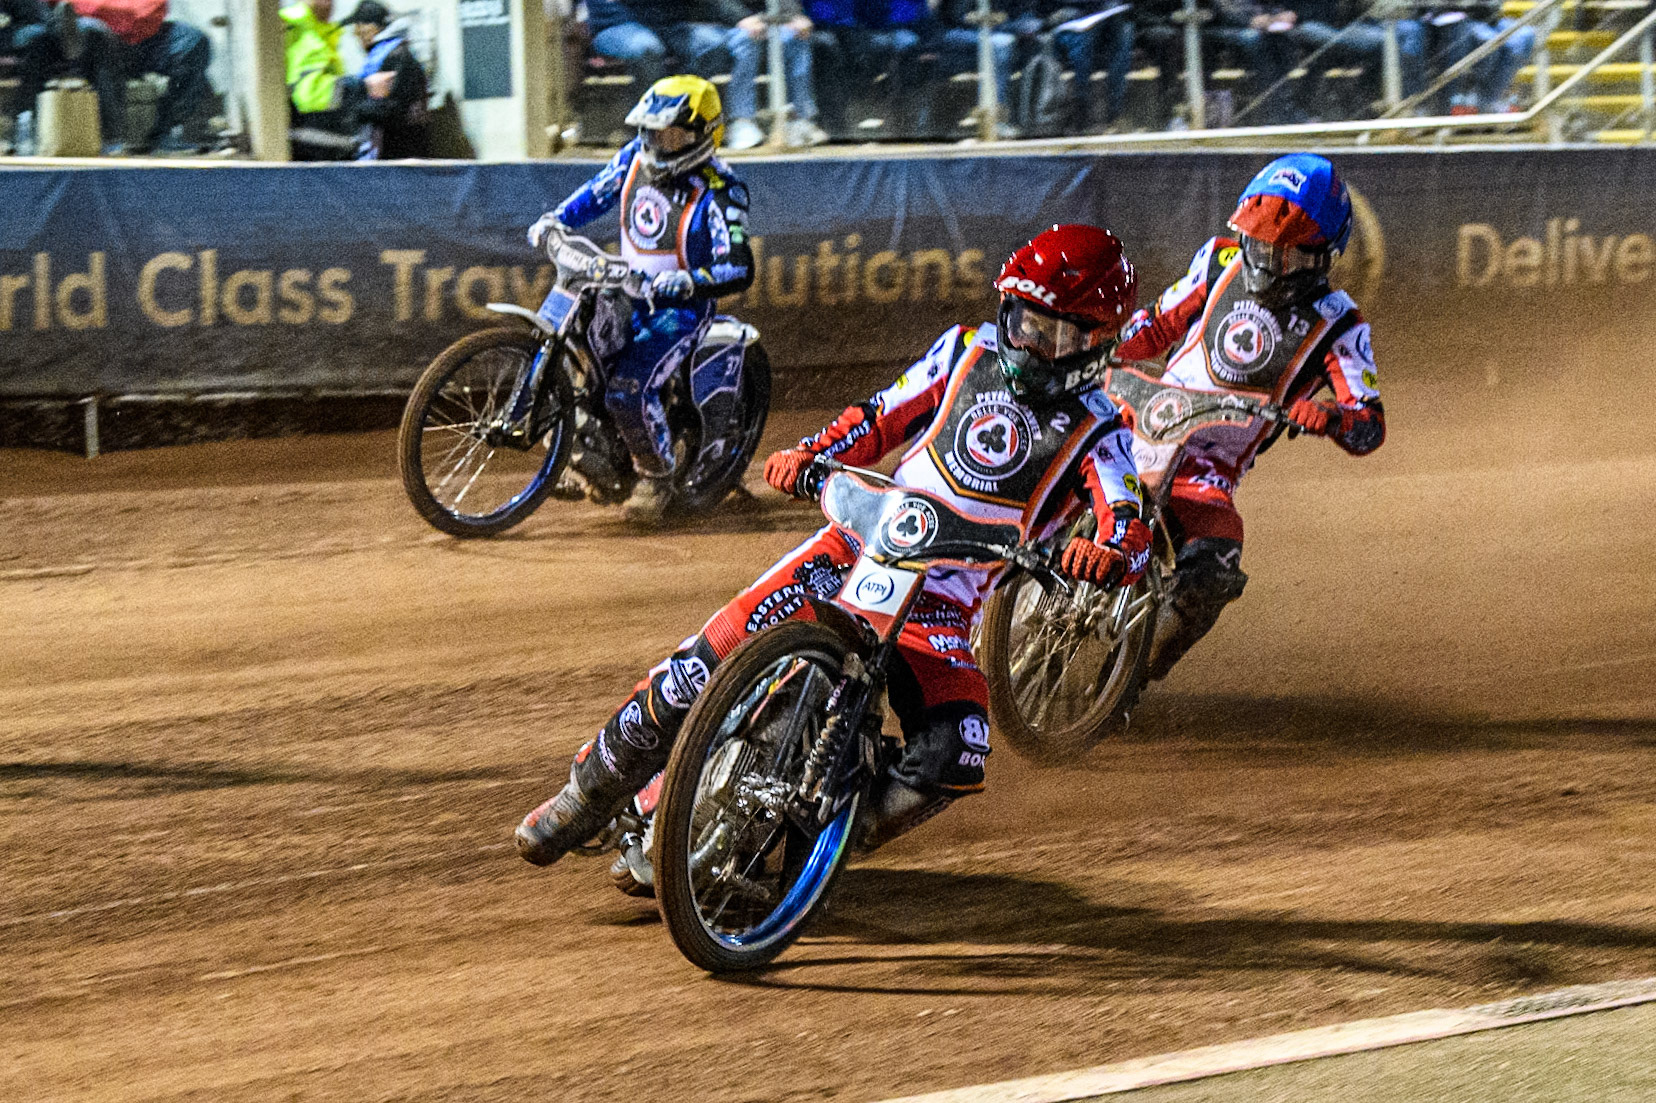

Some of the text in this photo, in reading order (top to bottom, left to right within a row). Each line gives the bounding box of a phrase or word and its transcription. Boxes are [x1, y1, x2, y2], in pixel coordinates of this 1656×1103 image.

[138, 250, 353, 327] Class
[379, 249, 558, 320] Trav
[744, 232, 986, 307] lutions
[944, 450, 999, 493] MEMORIAL
[746, 582, 806, 633] EASTERN
[862, 581, 888, 597] ATPI
